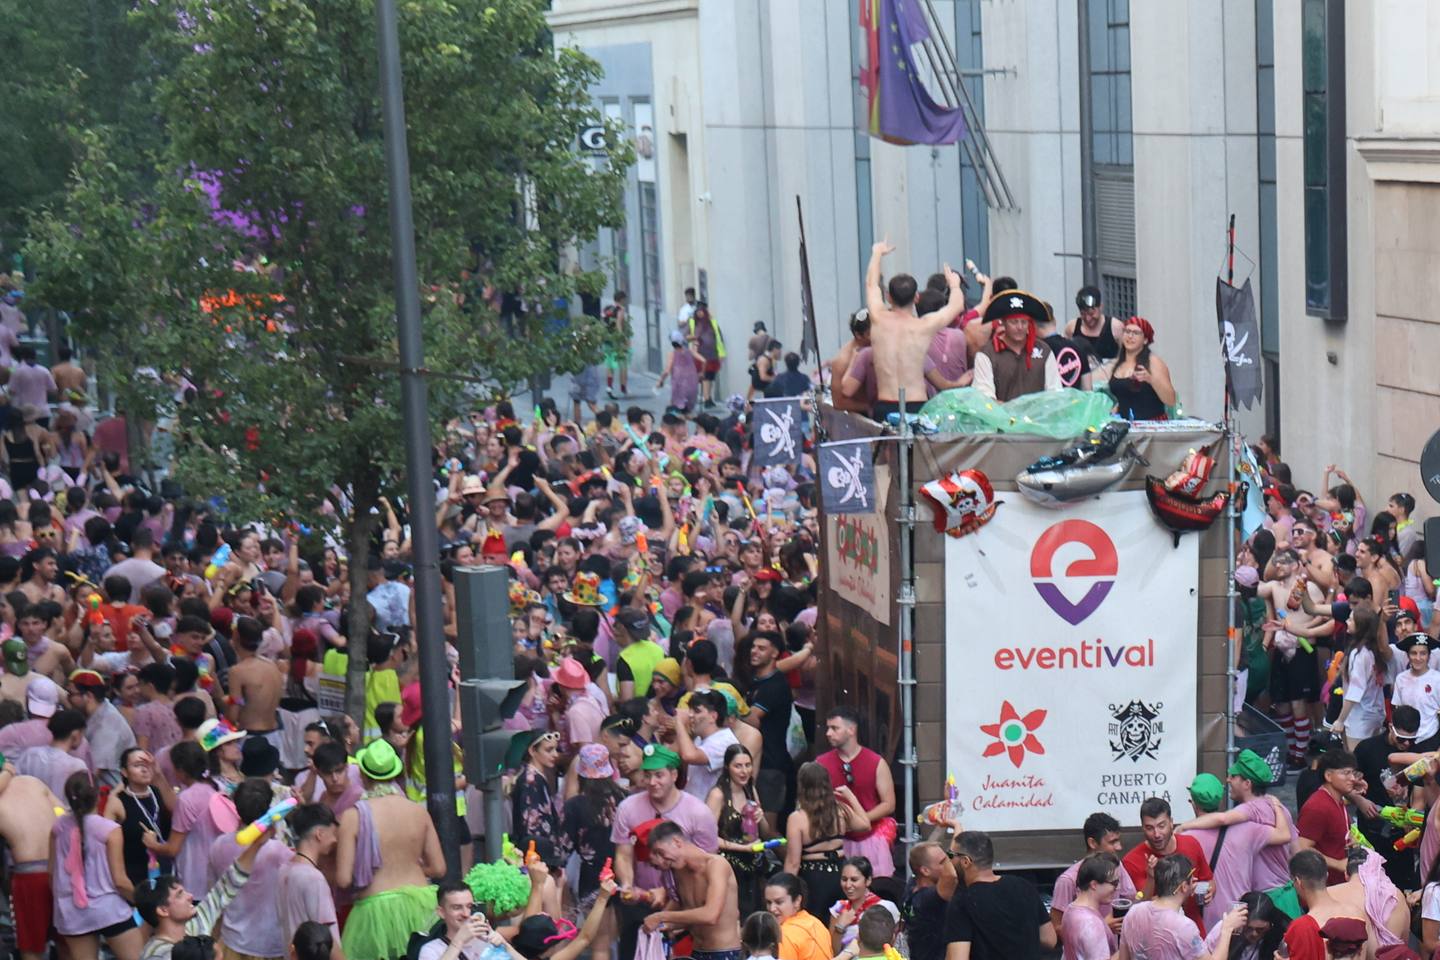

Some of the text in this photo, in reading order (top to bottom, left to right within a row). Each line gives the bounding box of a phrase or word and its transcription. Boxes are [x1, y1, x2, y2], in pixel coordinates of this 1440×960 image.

[994, 638, 1154, 670] eventival
[982, 774, 1045, 791] Juanita
[1101, 772, 1167, 787] PUERTO
[973, 793, 1054, 811] Calamidad
